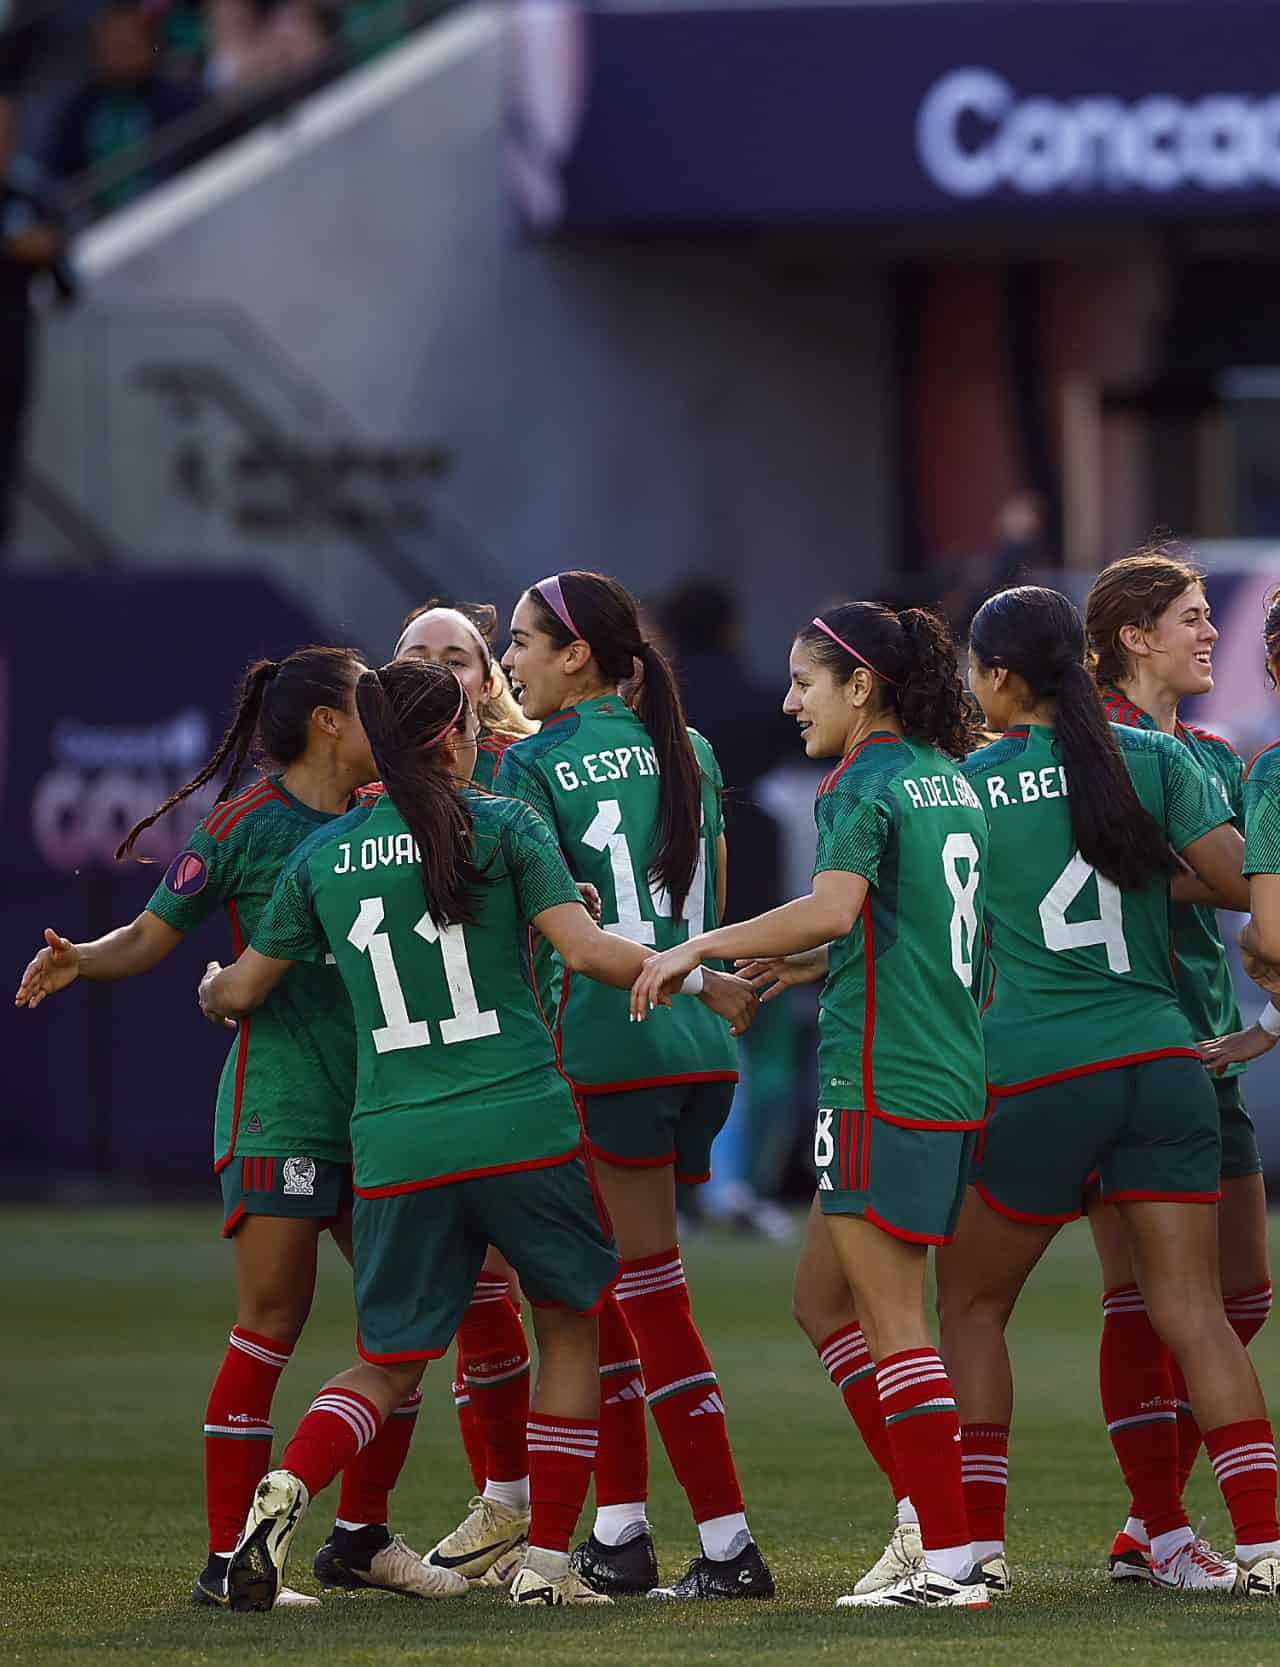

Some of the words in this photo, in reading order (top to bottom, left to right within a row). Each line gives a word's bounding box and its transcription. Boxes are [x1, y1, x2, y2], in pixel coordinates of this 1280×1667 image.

[986, 766, 1070, 808] R.BE
[942, 833, 980, 988] 8
[1038, 850, 1131, 974] 4
[347, 896, 501, 1054] 11
[814, 1108, 834, 1167] 8
